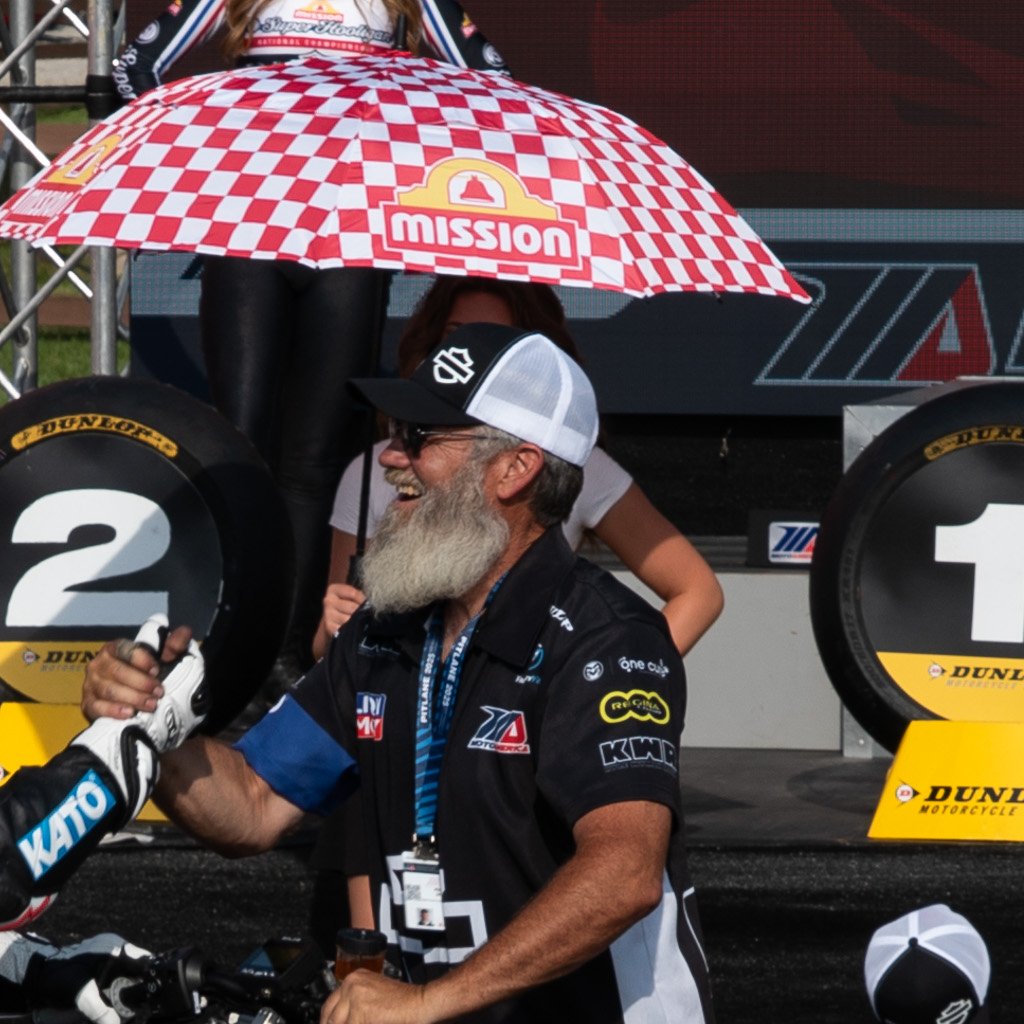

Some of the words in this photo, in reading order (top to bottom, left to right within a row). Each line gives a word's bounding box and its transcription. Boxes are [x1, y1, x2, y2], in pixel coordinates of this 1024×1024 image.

[263, 17, 311, 36] Super
[39, 416, 153, 438] DUNLOP
[6, 489, 171, 627] 2
[934, 503, 1024, 644] 1
[447, 635, 467, 683] PITLANE
[420, 676, 431, 723] PITLANE
[18, 780, 107, 881] KATO
[919, 805, 1018, 816] MOTORCYCLE
